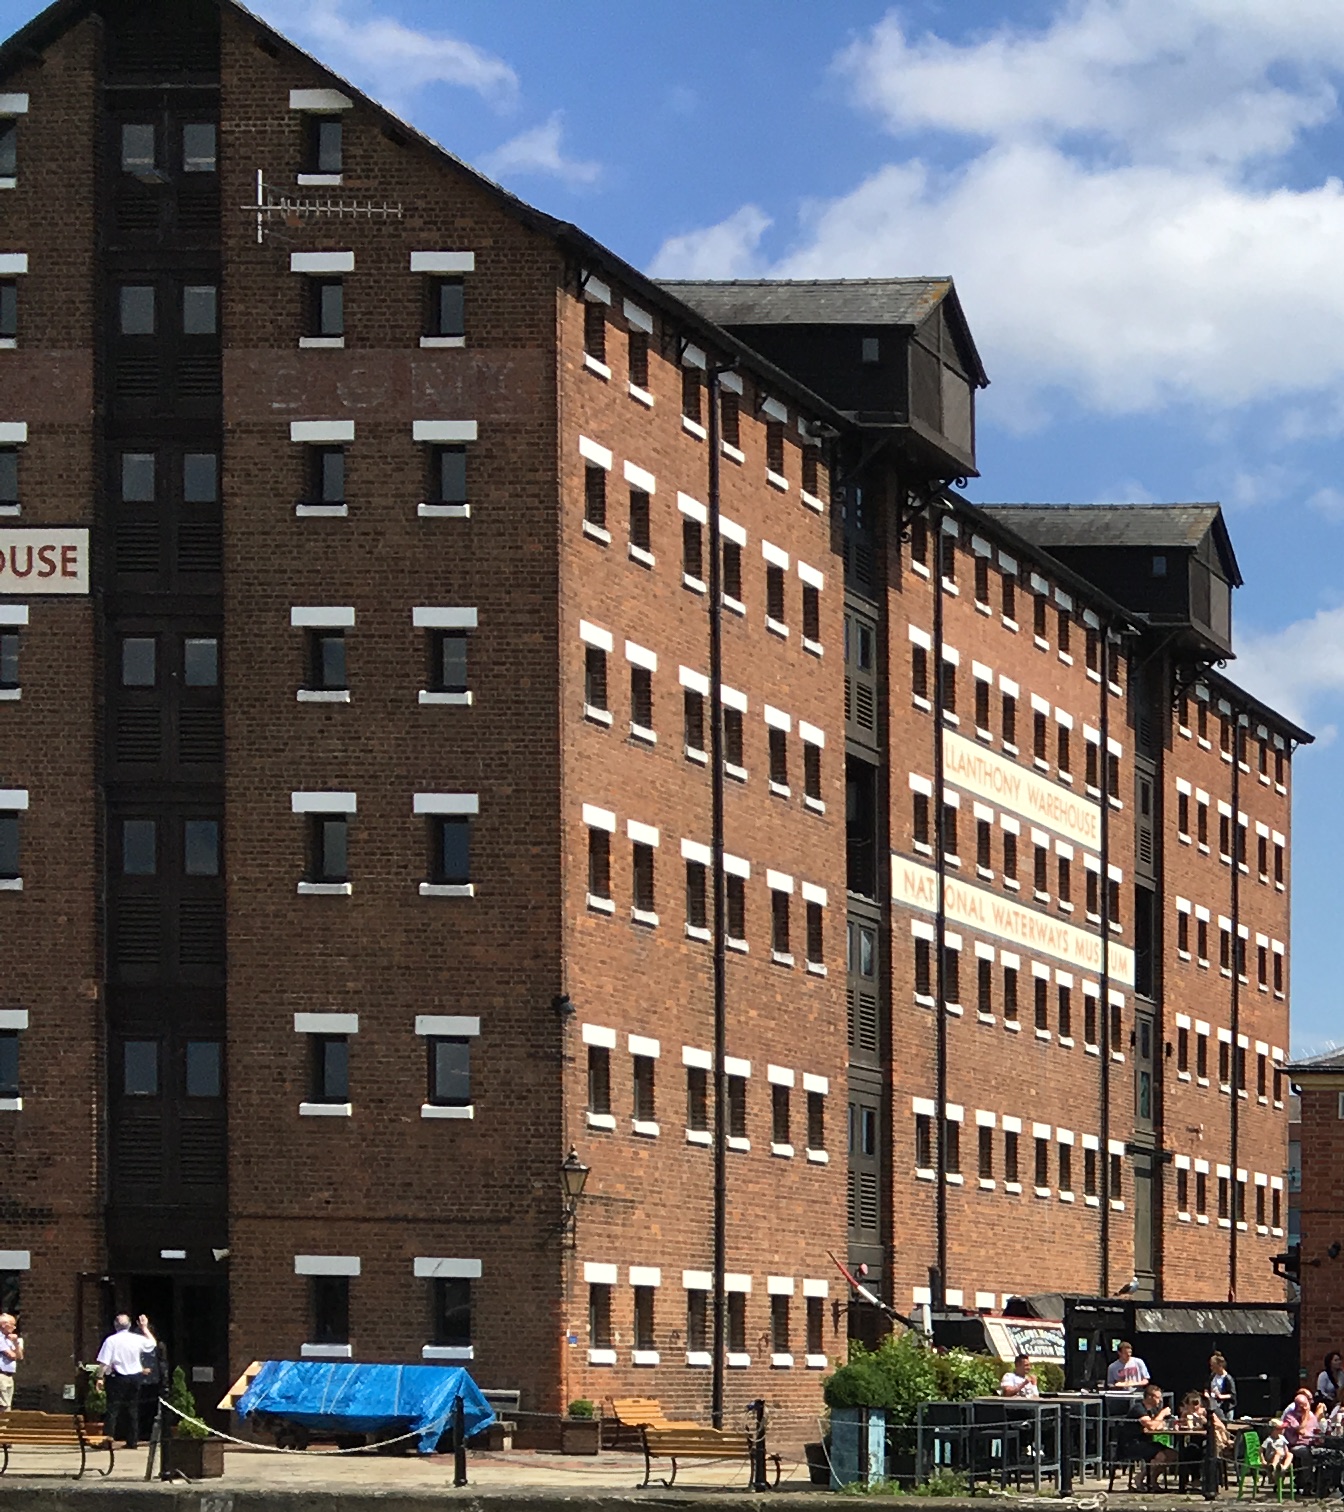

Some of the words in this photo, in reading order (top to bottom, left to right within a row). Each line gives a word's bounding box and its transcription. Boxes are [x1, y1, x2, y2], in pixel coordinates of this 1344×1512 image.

[0, 545, 77, 577] USE
[945, 742, 1021, 800] LLANTHONY
[1027, 781, 1097, 840] WAREHOUSE
[903, 869, 985, 923] NATONAL
[992, 902, 1069, 953] WATERWAYS
[1075, 940, 1128, 976] MUSUM
